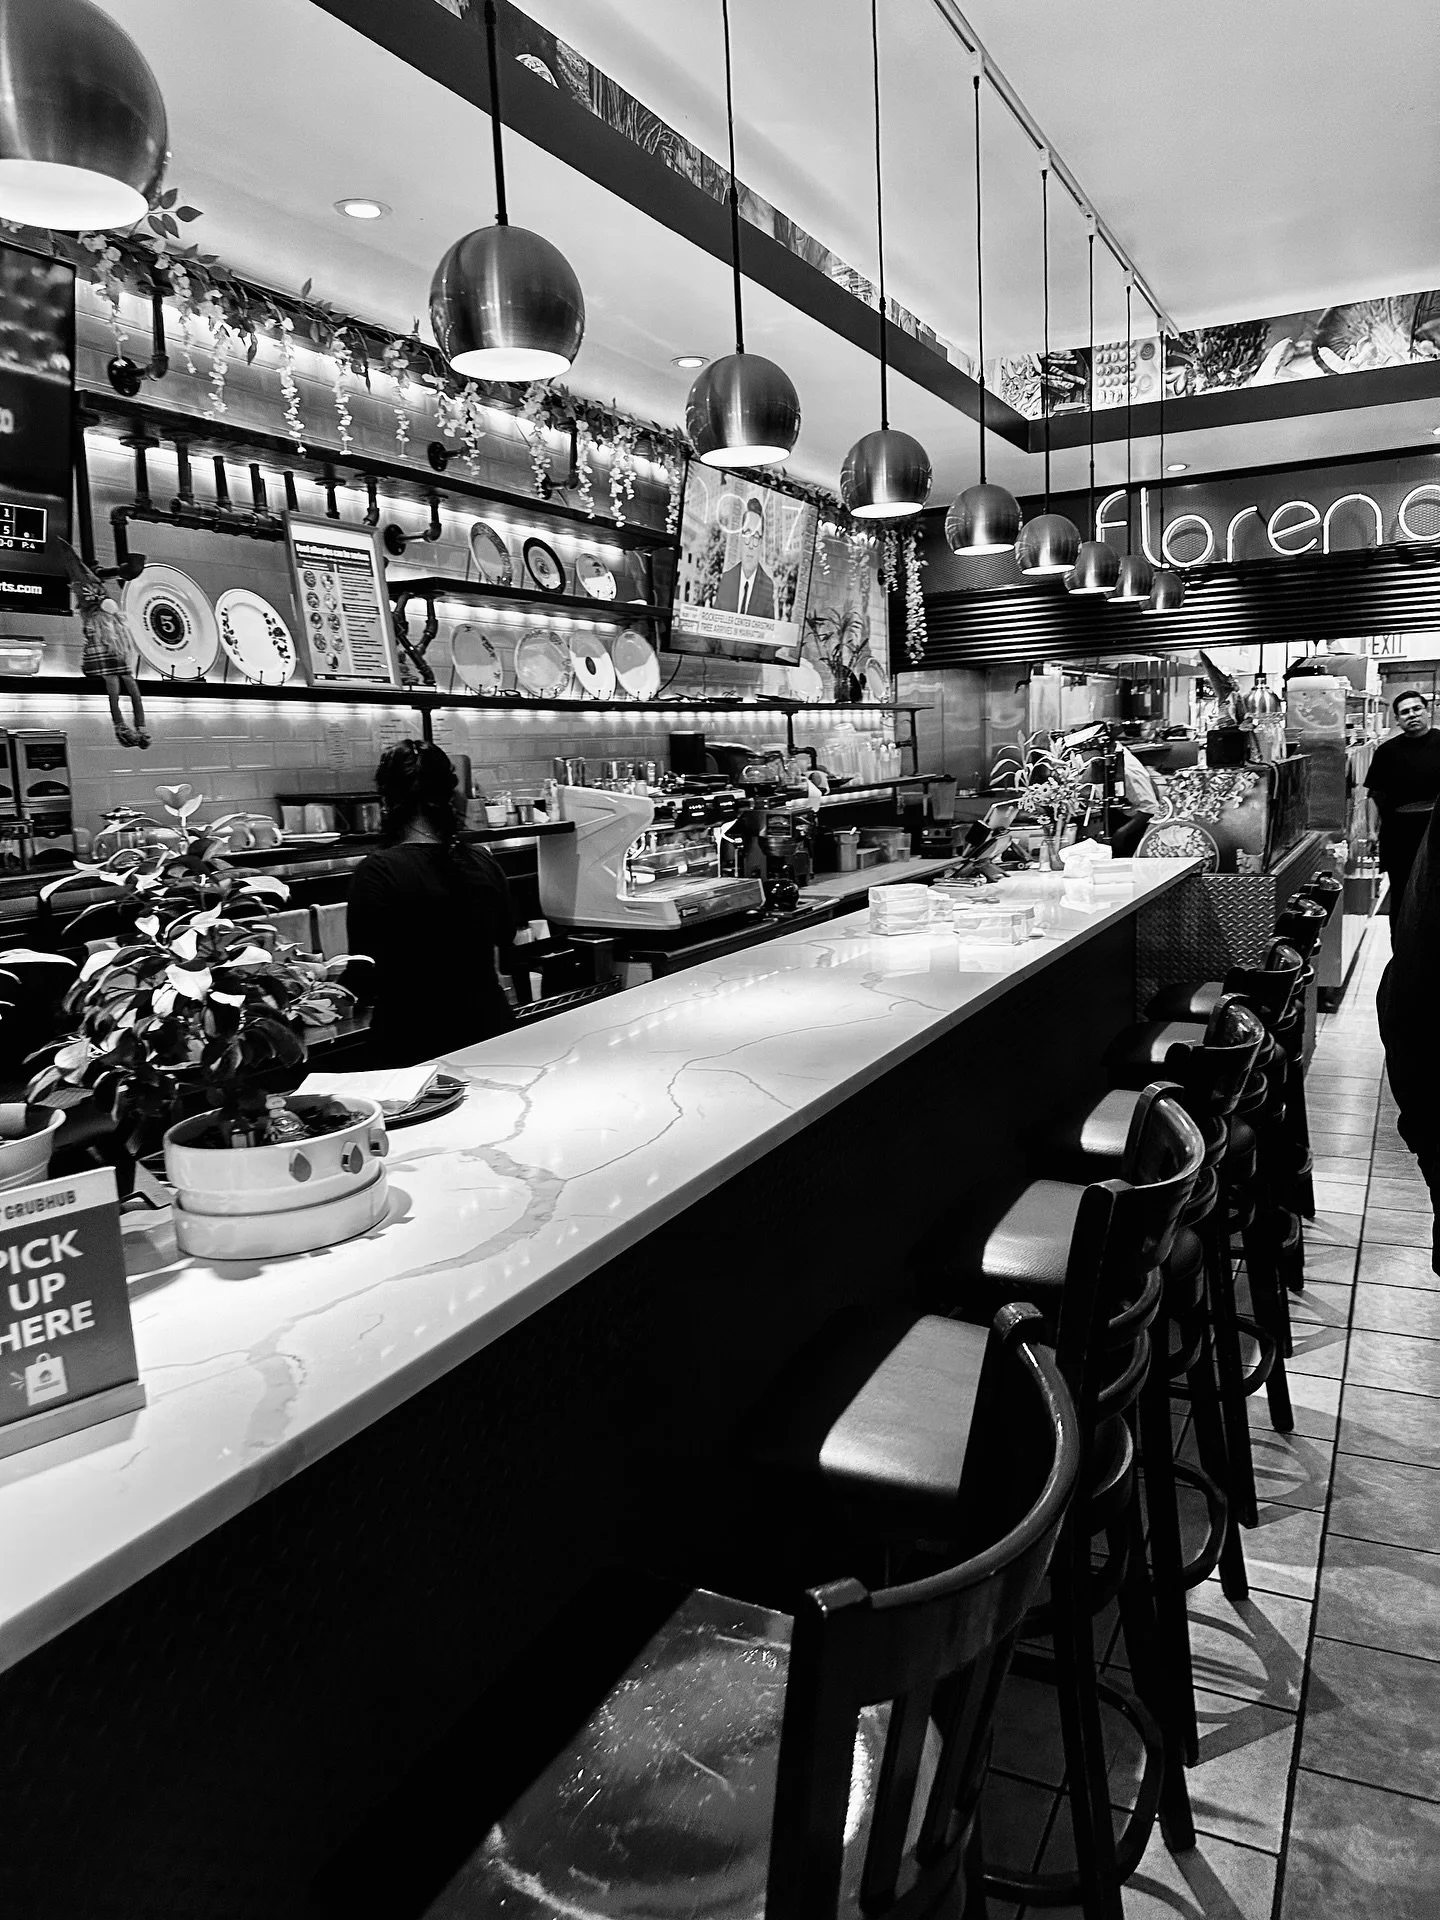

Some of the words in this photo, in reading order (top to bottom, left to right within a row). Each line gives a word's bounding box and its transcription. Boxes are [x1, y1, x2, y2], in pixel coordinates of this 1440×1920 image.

[3, 525, 10, 535] 5
[160, 615, 176, 633] 5
[5, 1190, 76, 1220] GRUBHUB
[8, 1272, 66, 1312] UP
